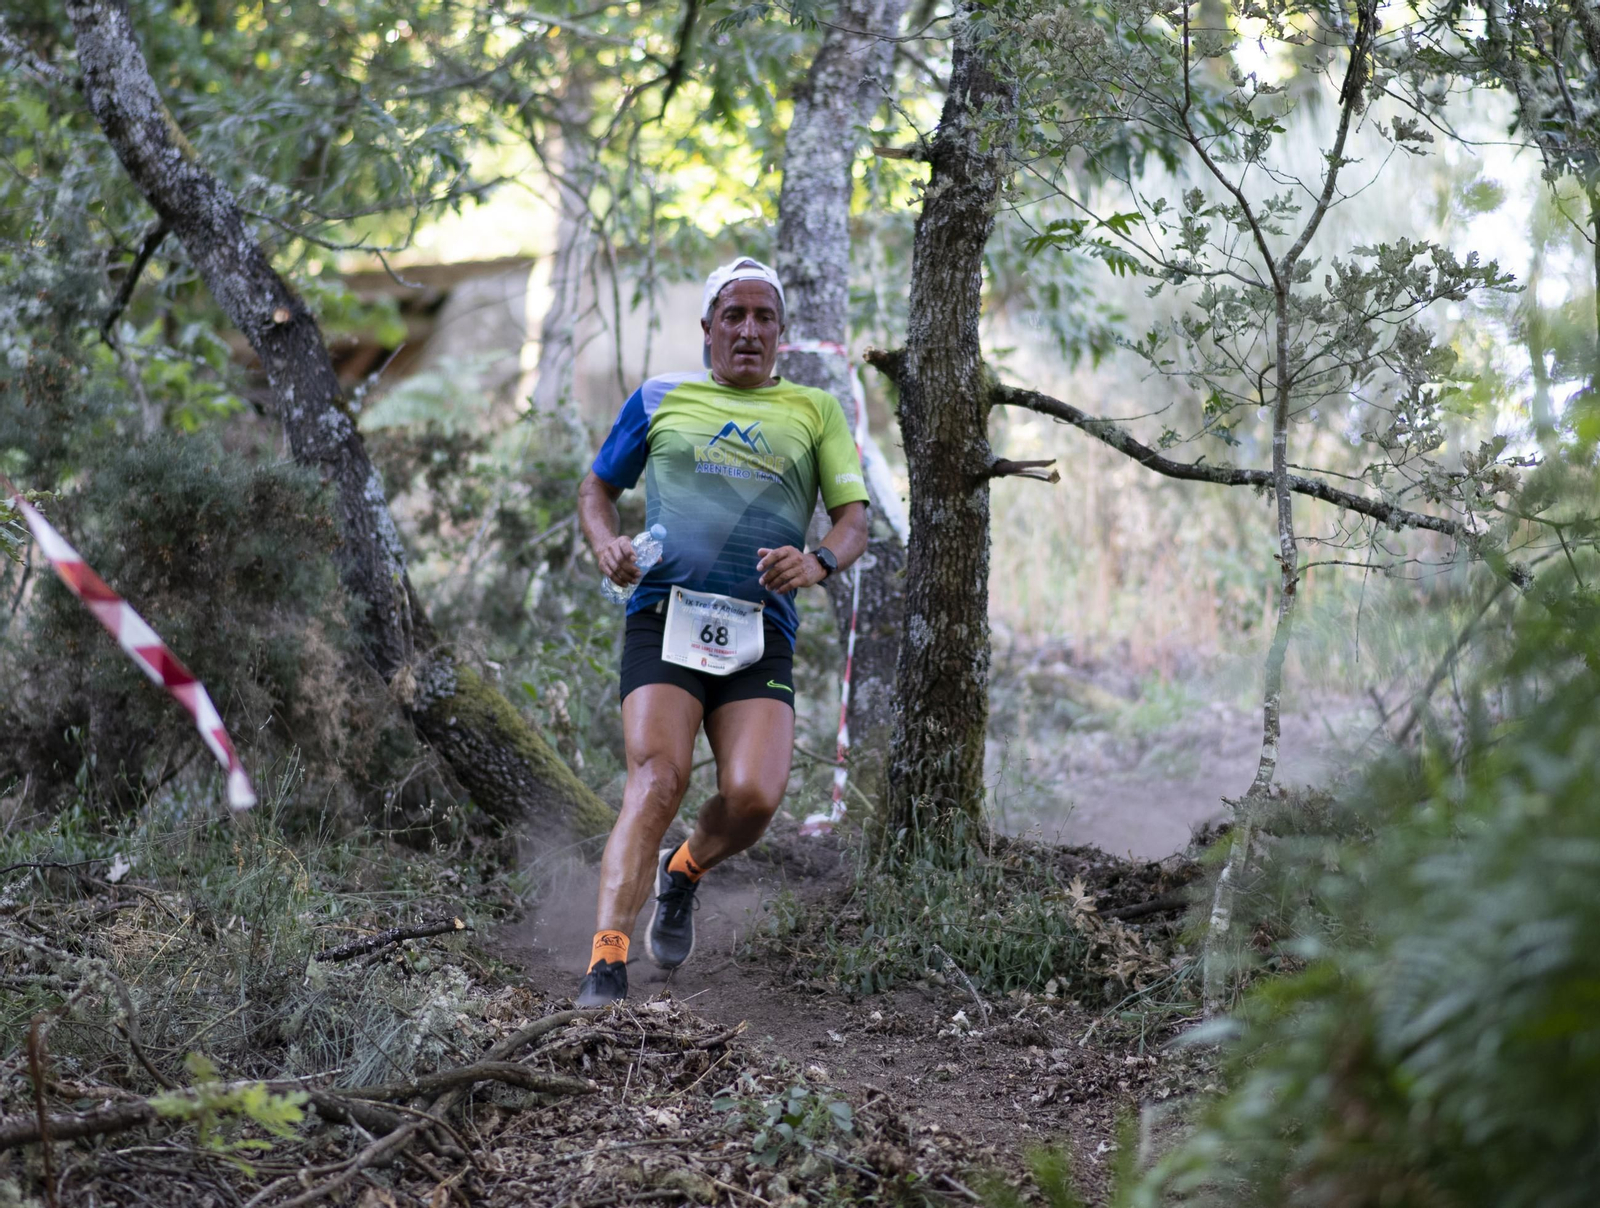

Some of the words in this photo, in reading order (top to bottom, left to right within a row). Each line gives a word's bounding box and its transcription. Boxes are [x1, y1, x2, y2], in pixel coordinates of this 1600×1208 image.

[694, 445, 785, 475] KORPORE
[695, 462, 751, 479] ARENTEIRO
[755, 470, 782, 484] TRAIL
[700, 624, 728, 646] 68
